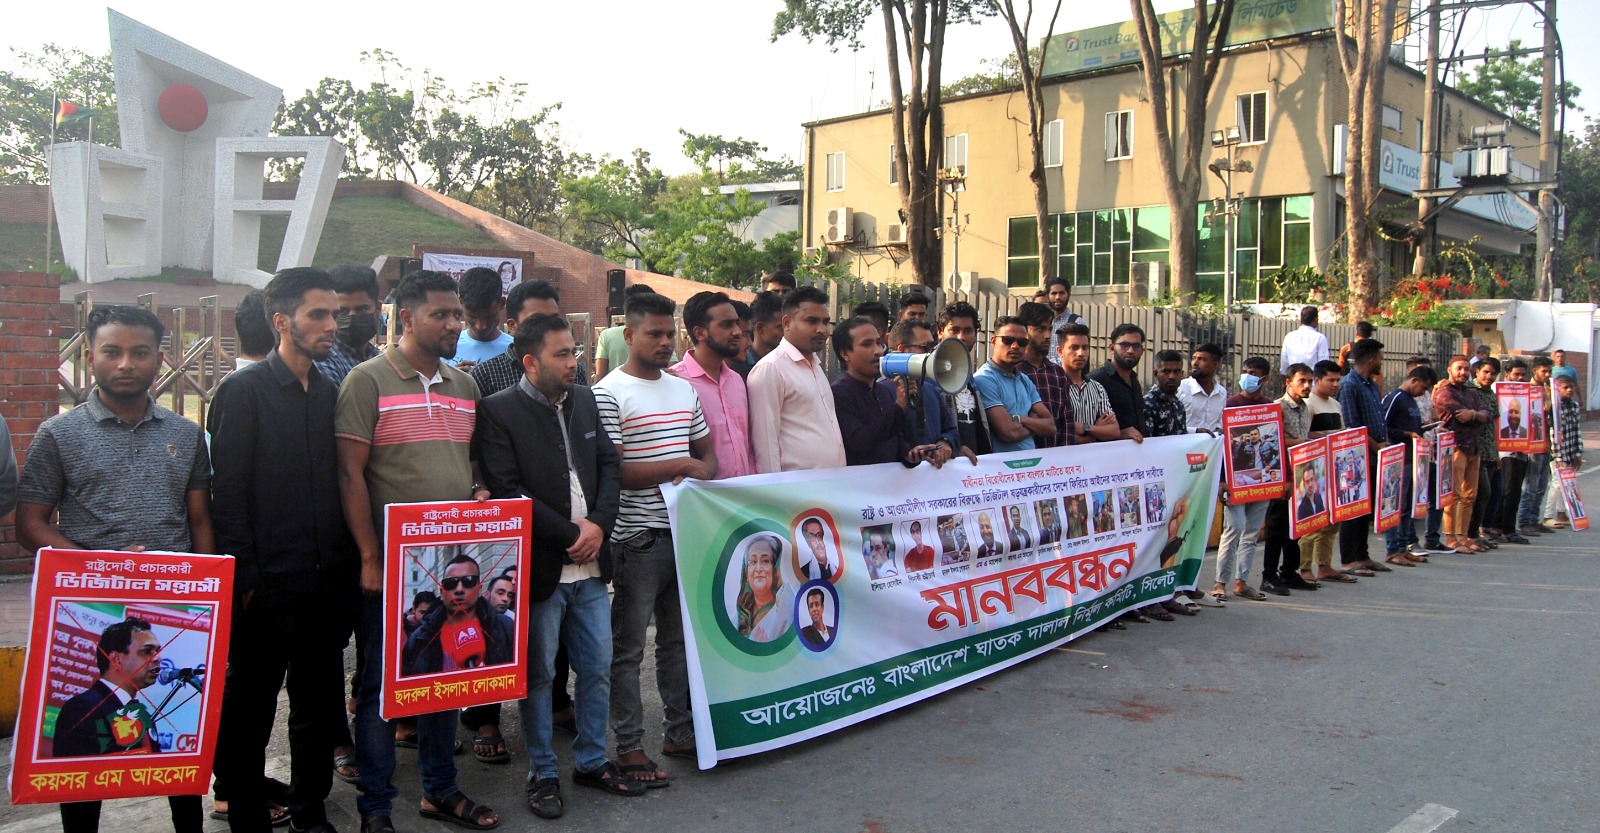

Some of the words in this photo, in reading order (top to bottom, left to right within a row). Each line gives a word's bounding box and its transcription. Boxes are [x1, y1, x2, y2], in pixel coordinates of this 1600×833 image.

[1080, 35, 1113, 50] Trust
[1115, 32, 1139, 44] Ban
[1397, 158, 1420, 180] Trust
[962, 475, 984, 488] স্বাধীনতা
[1016, 472, 1025, 482] স্থান
[1026, 470, 1044, 479] বাংলার
[1045, 466, 1063, 476] মাটিতে
[1064, 466, 1075, 475] হবে
[862, 504, 876, 520] রাষ্ট্র
[878, 507, 884, 517] ও
[886, 498, 926, 517] আওয়ামীলীগ
[927, 496, 957, 510] সরকারের
[958, 492, 981, 507] বিরুদ্ধে
[982, 488, 1008, 503] ডিজিটাল
[1053, 480, 1068, 492] দেশে
[1069, 477, 1088, 490] ফিরিয়ে
[1089, 474, 1110, 486] আইনের
[1110, 472, 1129, 484] মাধ্যমে
[1130, 468, 1145, 480] শাস্তির
[1146, 466, 1164, 479] দাবীতে
[462, 506, 501, 518] প্রচারকারী
[402, 522, 472, 536] ডিজিটাল
[474, 516, 522, 534] সন্ত্রাসী
[139, 560, 192, 574] প্রচারকারী
[55, 572, 151, 591] ডিজিটাল
[155, 577, 220, 595] সন্ত্রাসী
[920, 542, 1138, 631] মানববন্ধন
[740, 676, 876, 726] আয়োজনেঃ
[881, 645, 970, 687] বাংলাদেশ
[974, 630, 1024, 657] ঘাতক
[1027, 614, 1071, 641] দালাল
[1072, 601, 1104, 626] নির্মূল
[1104, 584, 1136, 608] কমিটি,
[1140, 570, 1176, 594] সিলেট
[394, 686, 431, 706] ছদরুল
[434, 680, 470, 700] ইসলাম
[472, 674, 516, 693] লোকমান
[29, 771, 89, 792] কয়সর
[94, 769, 125, 788] এম
[130, 766, 200, 786] আহমেদ
